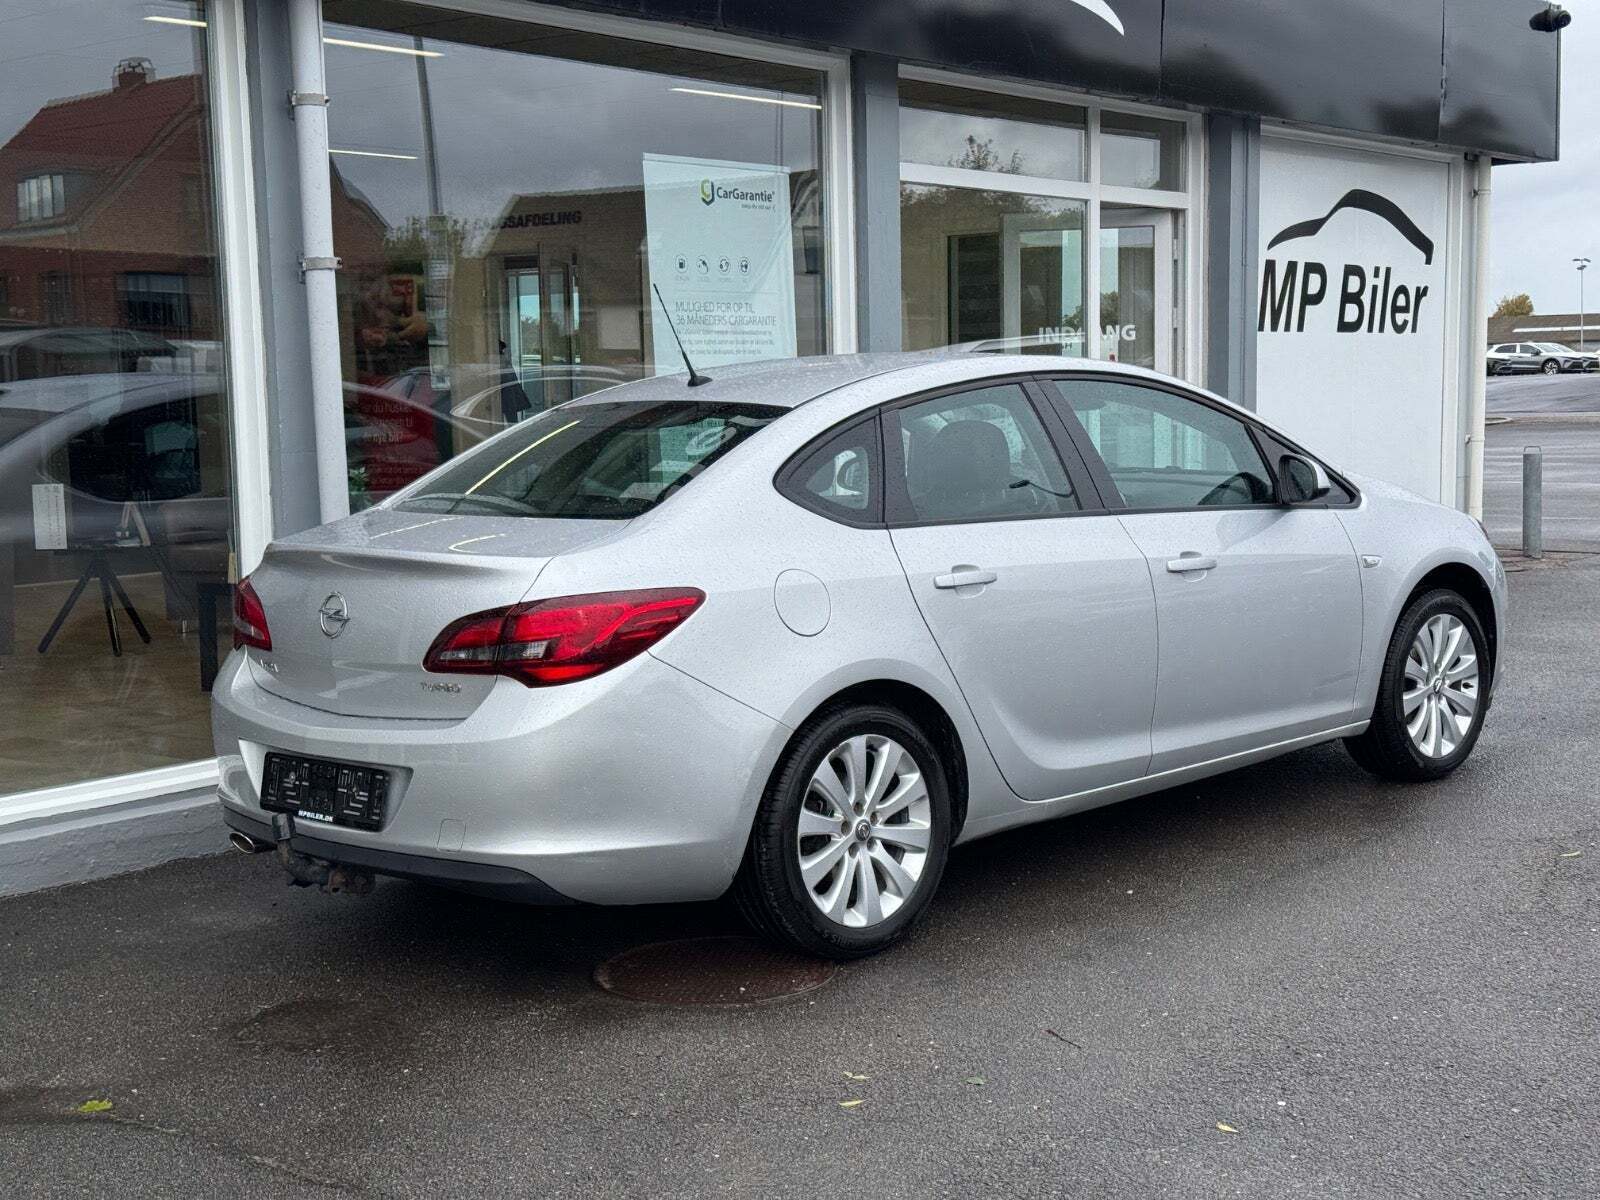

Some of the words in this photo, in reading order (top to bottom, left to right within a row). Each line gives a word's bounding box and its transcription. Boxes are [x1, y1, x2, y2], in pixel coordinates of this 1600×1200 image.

[716, 186, 775, 202] CarGarantie
[1257, 259, 1328, 332] MP
[1336, 264, 1429, 334] Biler
[675, 301, 714, 313] MULIGHED
[716, 302, 732, 313] FOR
[733, 302, 743, 313] OP
